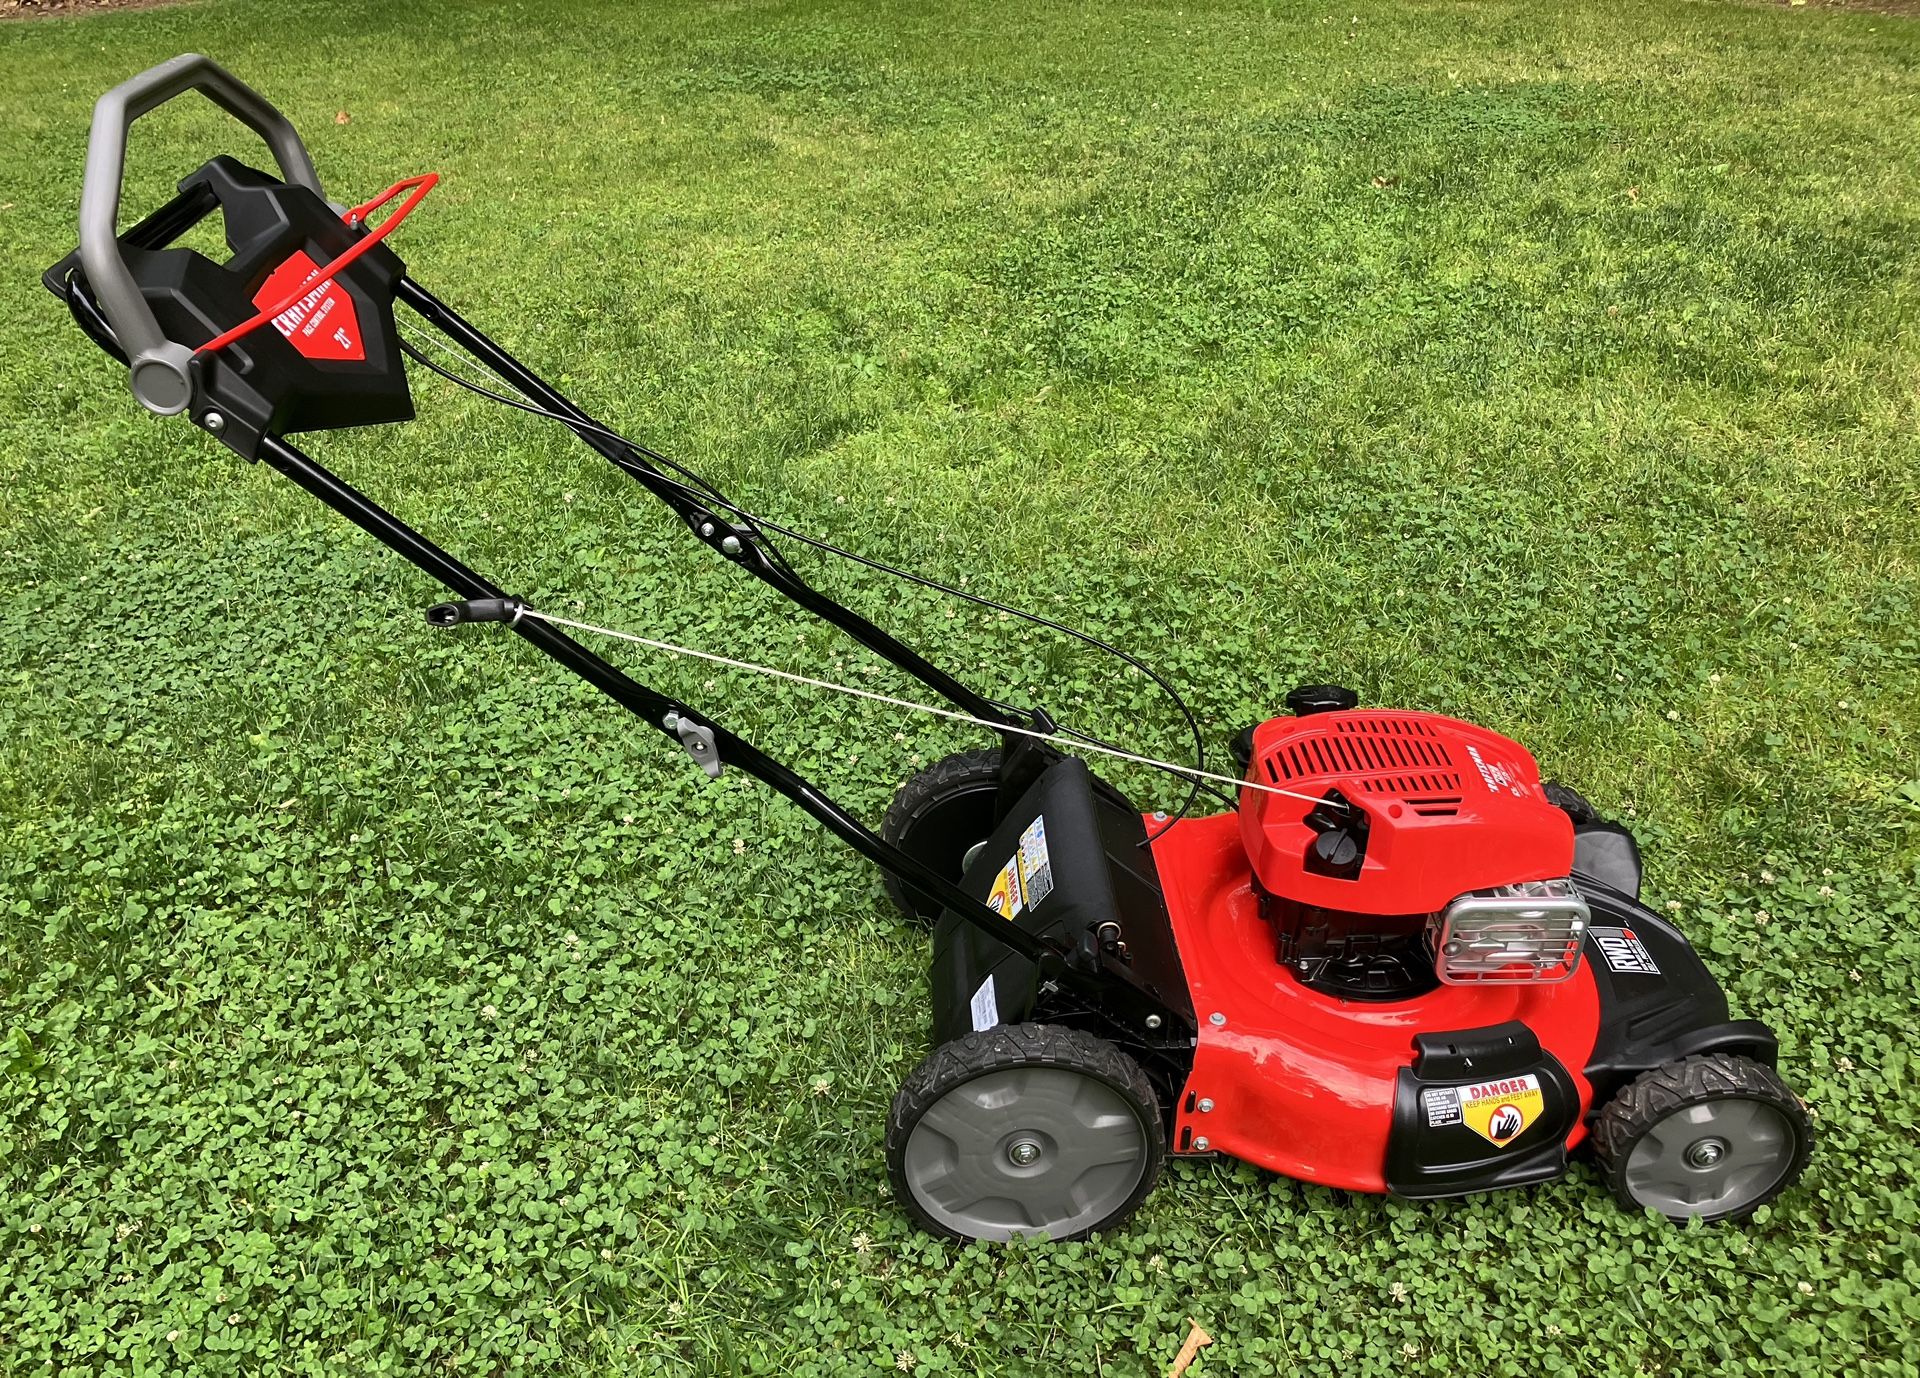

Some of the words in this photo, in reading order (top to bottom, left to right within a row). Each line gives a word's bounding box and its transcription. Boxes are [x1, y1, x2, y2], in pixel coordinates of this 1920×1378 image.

[1008, 866, 1018, 906] DANGER
[1598, 937, 1643, 970] RWD
[1465, 1100, 1480, 1109] KEEP
[1481, 1097, 1500, 1107] HANDS
[1501, 1095, 1510, 1103] and
[1510, 1092, 1523, 1102] FEET
[1523, 1090, 1539, 1099] AWAY
[1470, 1078, 1528, 1099] DANGER
